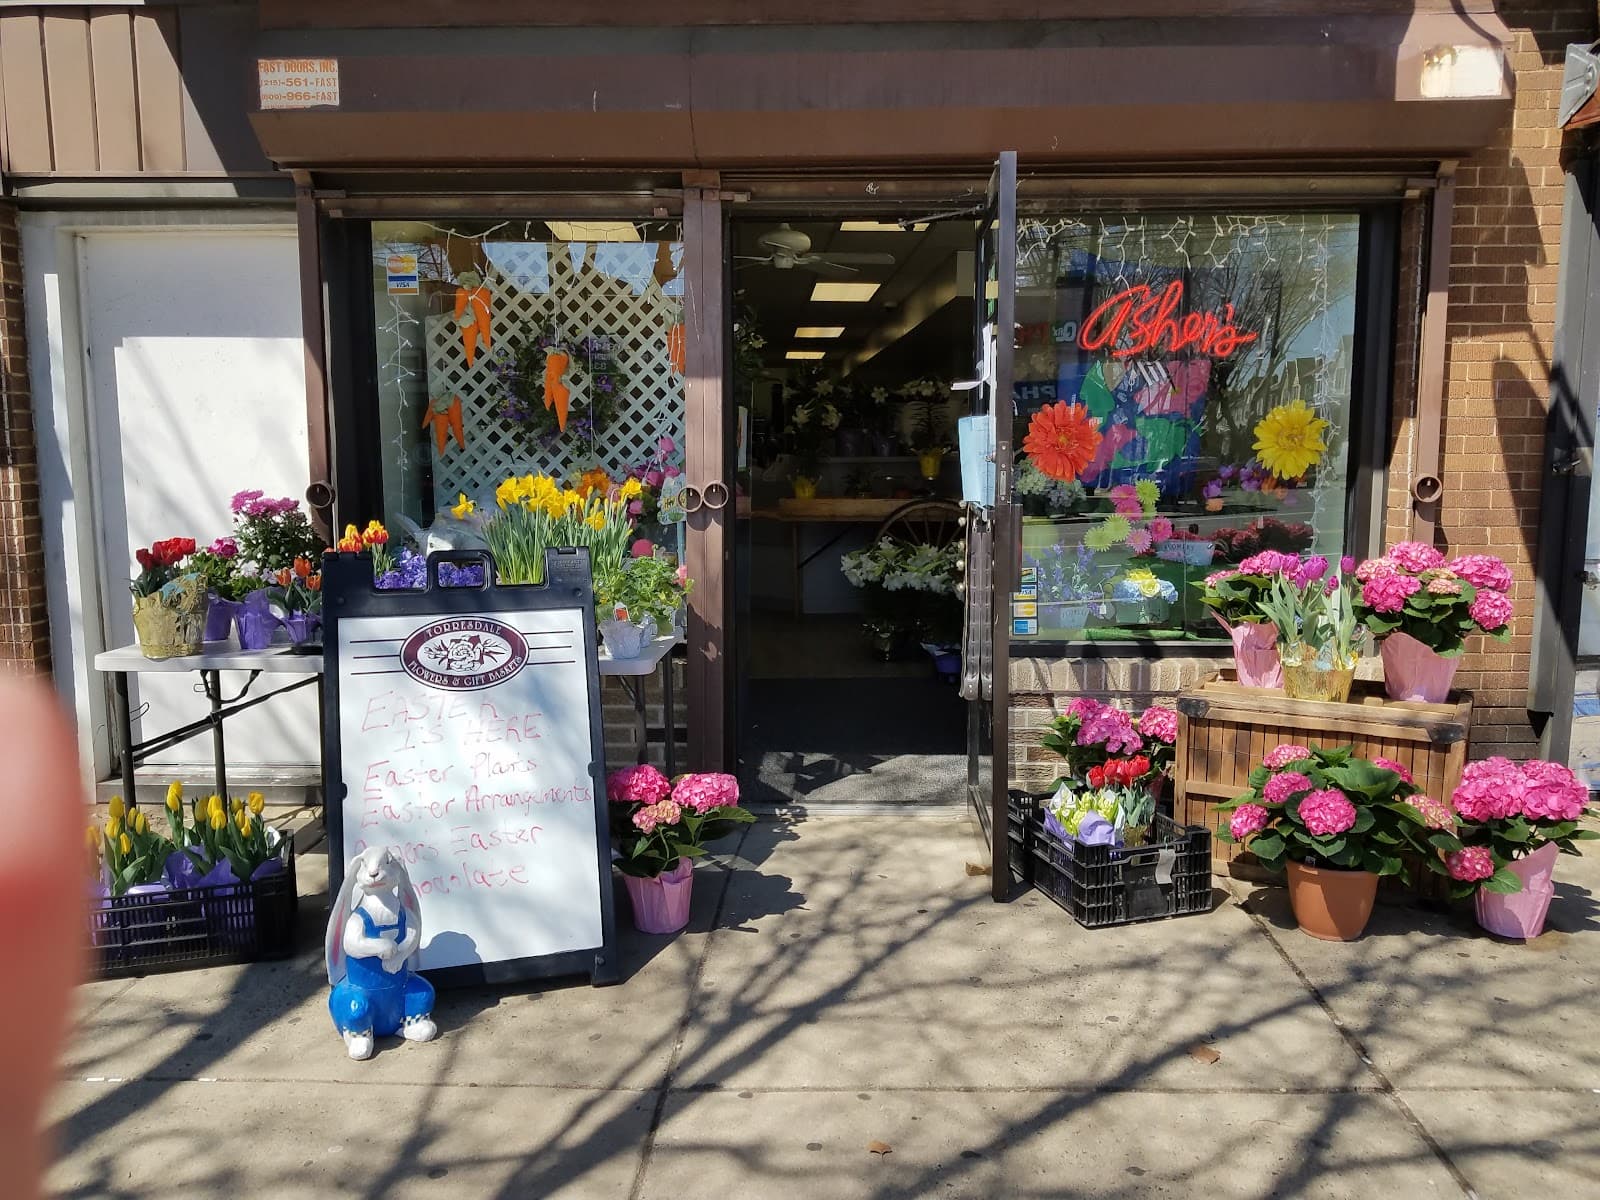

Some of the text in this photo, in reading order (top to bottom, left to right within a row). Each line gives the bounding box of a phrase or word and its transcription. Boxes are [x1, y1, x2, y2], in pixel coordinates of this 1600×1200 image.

[258, 61, 282, 74] FAST
[319, 60, 338, 73] INC.
[426, 621, 502, 638] TORRESDALE
[408, 655, 522, 686] FLOWERS & GIFT BASKETS
[393, 723, 446, 752] IS
[363, 751, 538, 793] Easter Plants
[360, 784, 593, 830] Easter Arrangements
[450, 820, 544, 857] Easter
